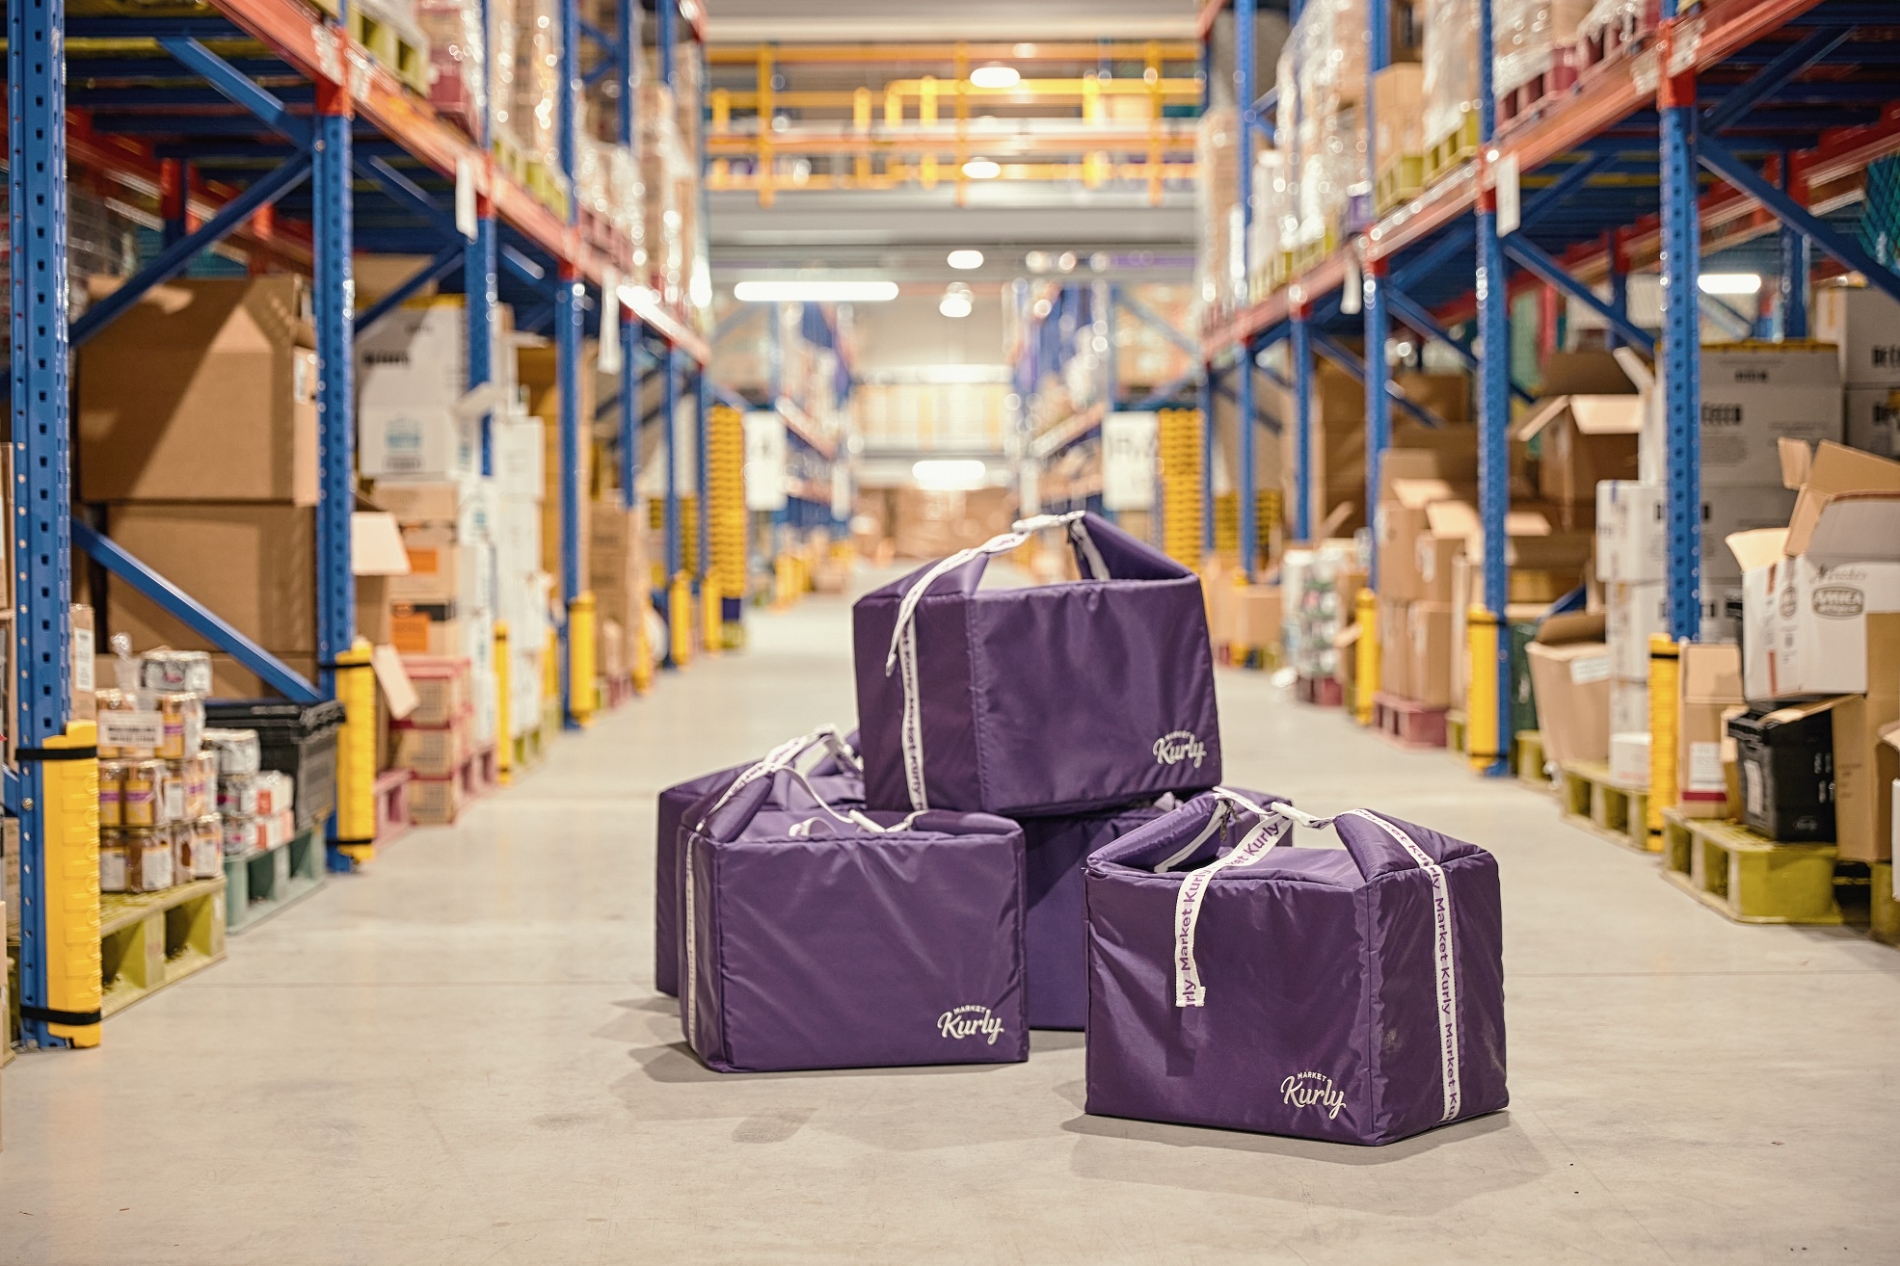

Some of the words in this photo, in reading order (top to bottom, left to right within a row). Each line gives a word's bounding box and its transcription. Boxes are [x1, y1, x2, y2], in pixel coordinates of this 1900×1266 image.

[1152, 734, 1207, 769] Kurly
[1243, 822, 1281, 857] Kurly
[1182, 869, 1212, 903] Kurly
[1179, 907, 1193, 971] Market
[1435, 897, 1449, 962] Market
[1182, 979, 1197, 1008] rly
[1440, 966, 1451, 1015] Kurly
[937, 1009, 1005, 1045] Kurly
[953, 1005, 988, 1015] MARKET
[1444, 1022, 1456, 1088] Market
[1297, 1071, 1328, 1082] MARKET
[1280, 1076, 1347, 1120] Kurly
